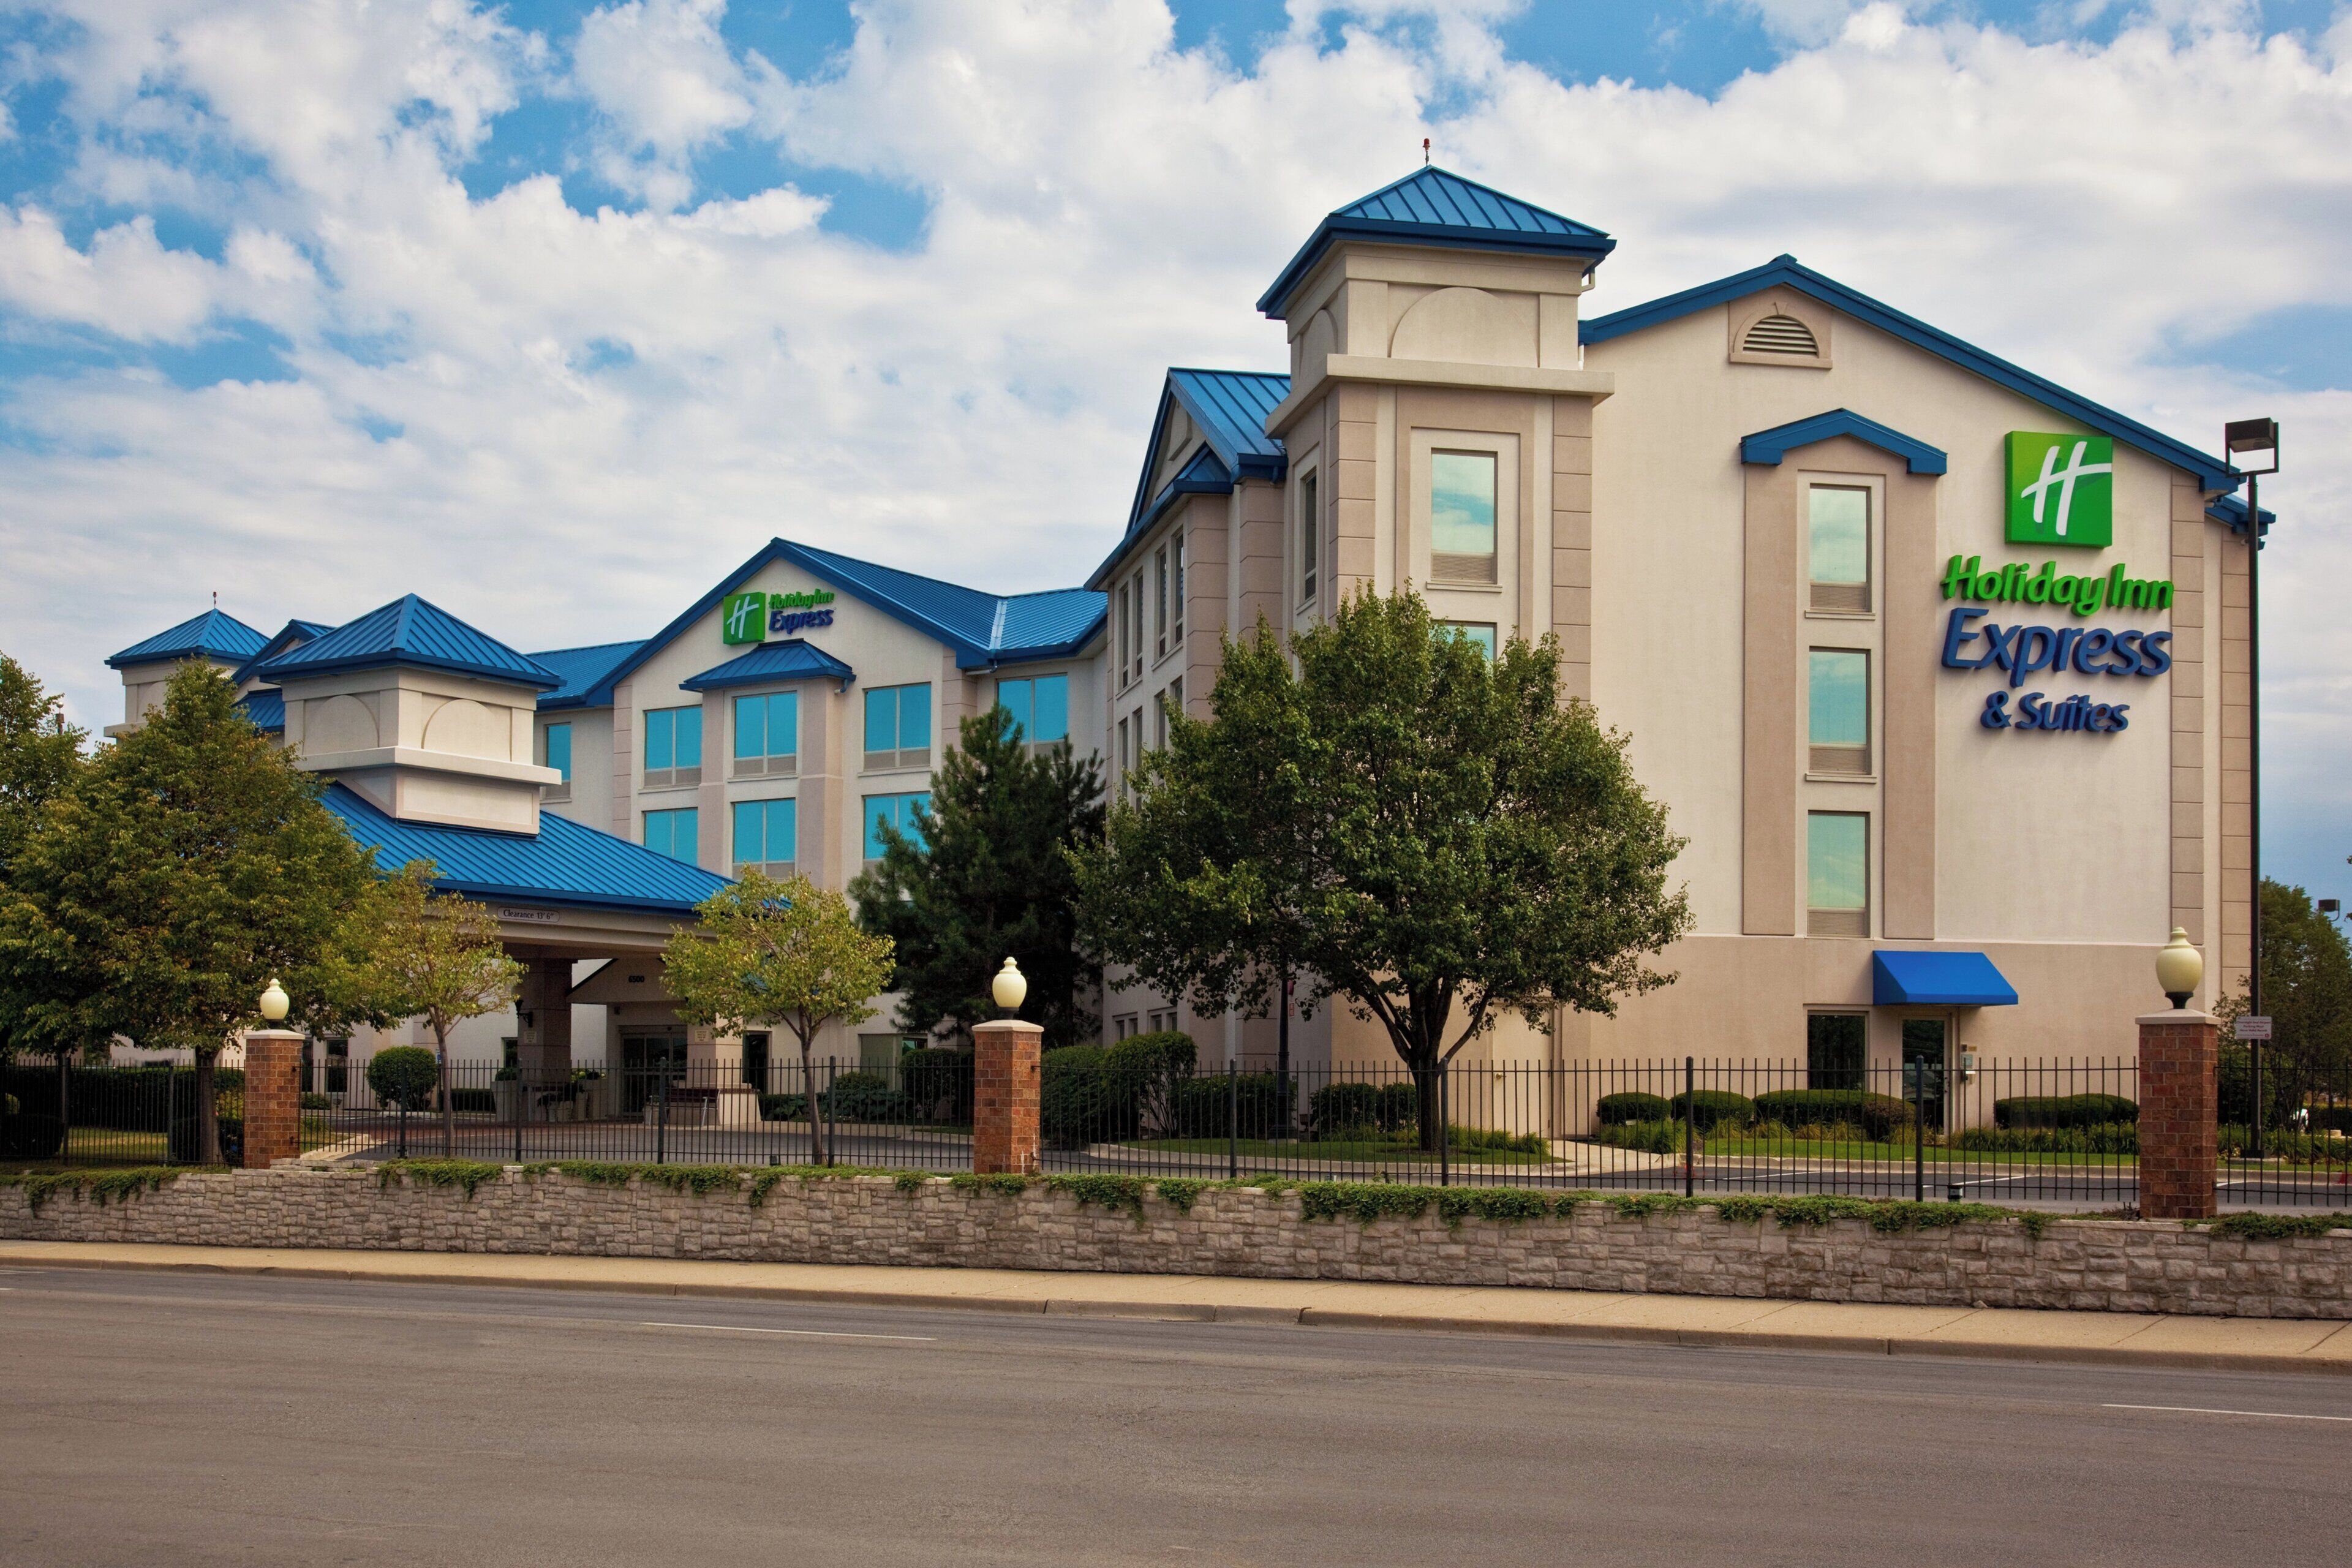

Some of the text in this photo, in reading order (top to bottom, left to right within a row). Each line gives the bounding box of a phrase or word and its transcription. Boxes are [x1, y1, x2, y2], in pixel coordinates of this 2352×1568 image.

[769, 589, 834, 609] Holiday Inn
[1940, 555, 2174, 617] Holiday Inn
[769, 609, 834, 635] Express
[1940, 607, 2173, 688] Express
[1980, 690, 2130, 733] & Suites
[503, 909, 534, 919] Clearance
